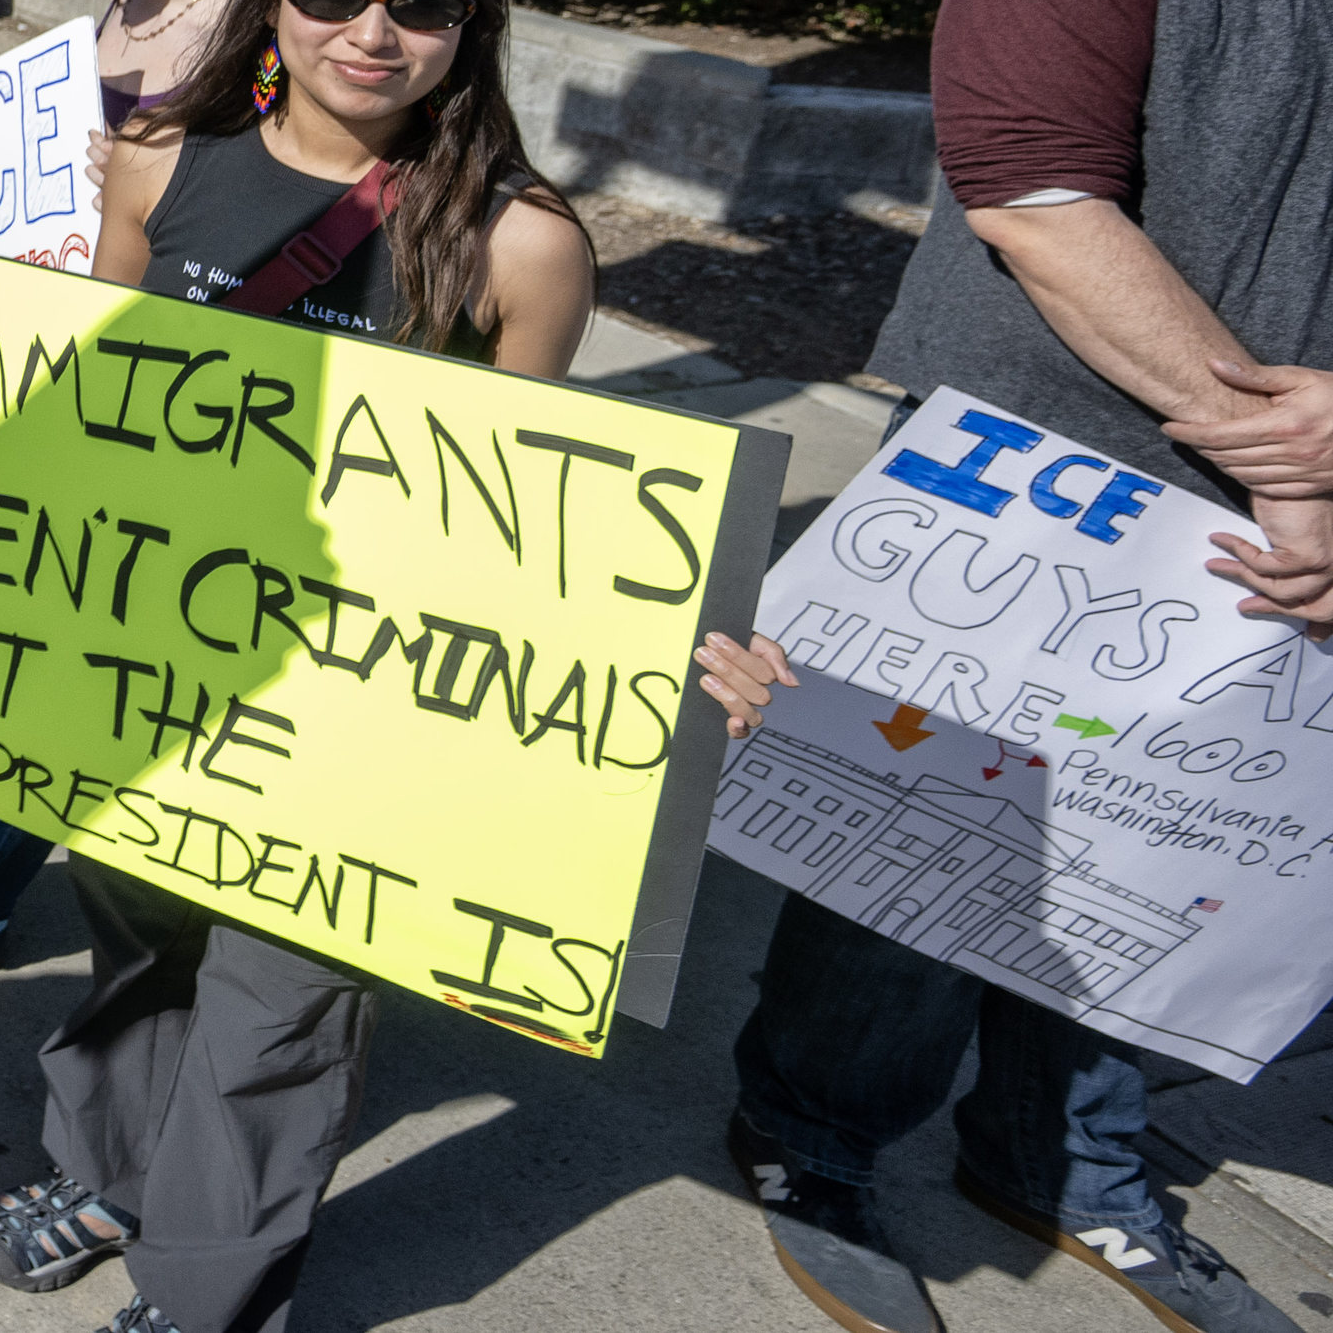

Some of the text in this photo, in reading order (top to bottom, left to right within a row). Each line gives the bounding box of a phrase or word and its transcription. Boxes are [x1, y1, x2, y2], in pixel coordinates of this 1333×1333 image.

[183, 259, 201, 278] NO
[207, 266, 243, 291] HUM
[881, 408, 1166, 544] ICE
[832, 498, 1200, 682] GUYS
[82, 652, 297, 795] THE
[776, 601, 1287, 783] HERE 1600
[1058, 749, 1306, 841] Pennsylvania
[1236, 839, 1313, 879] D.C.
